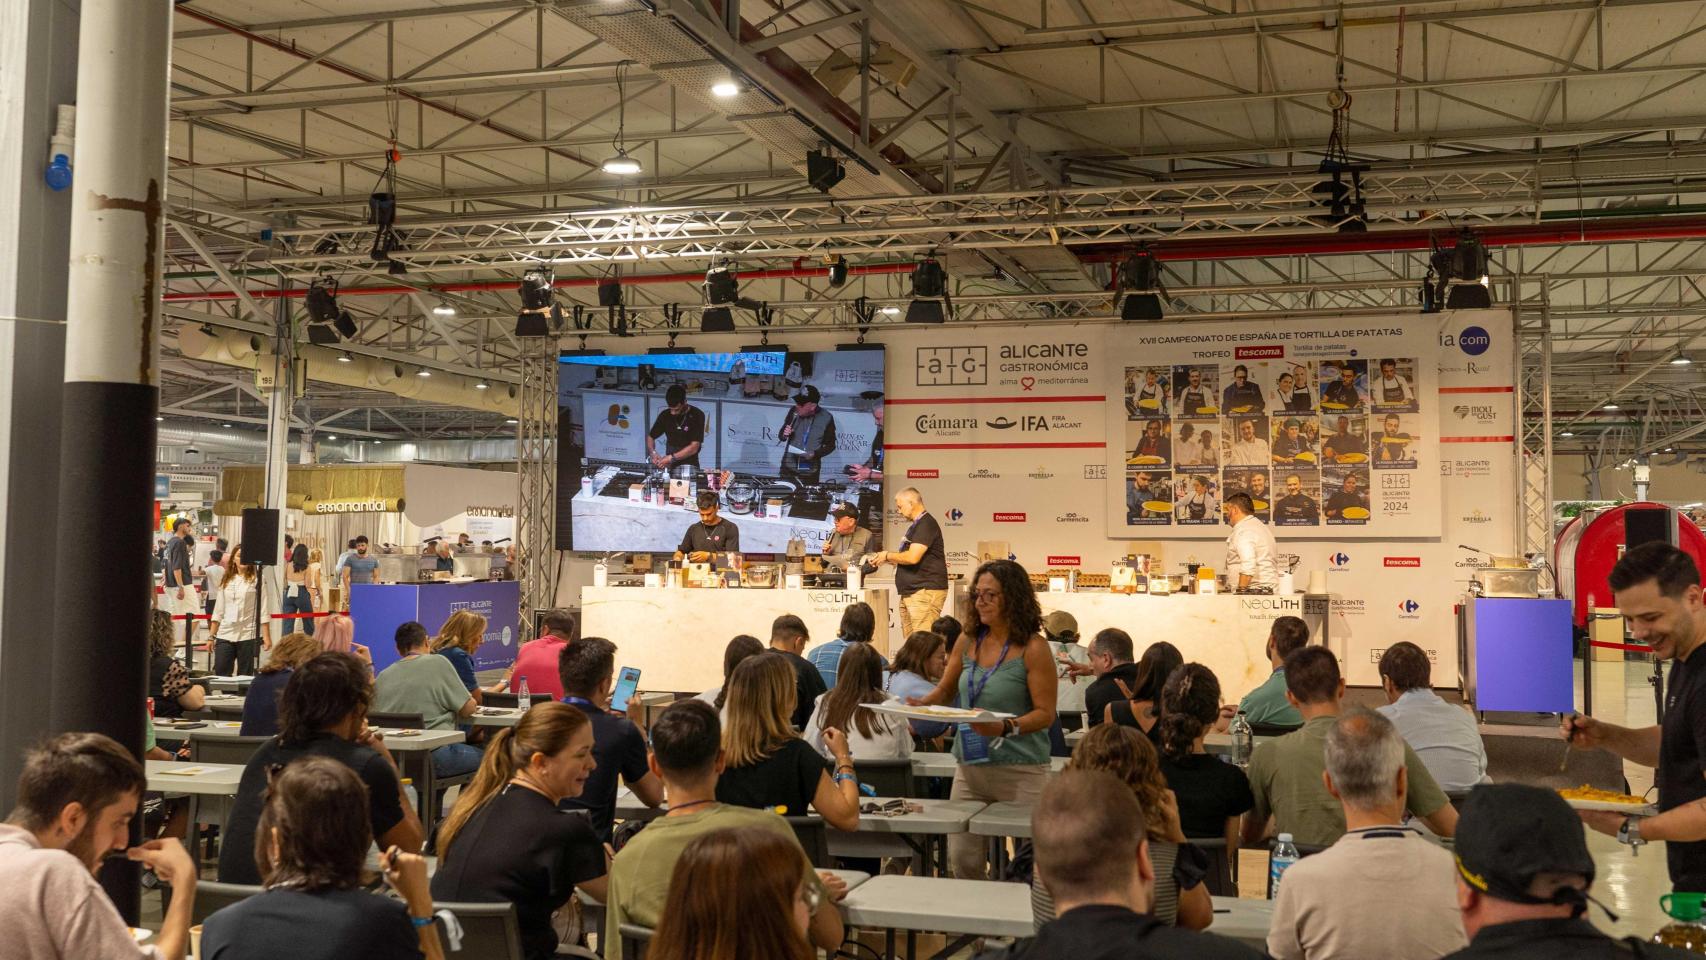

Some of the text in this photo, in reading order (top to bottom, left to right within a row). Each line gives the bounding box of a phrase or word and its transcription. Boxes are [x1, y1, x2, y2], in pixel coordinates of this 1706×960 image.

[1158, 334, 1224, 344] CAMPEONATO
[1239, 332, 1277, 341] ESPAÑA
[1294, 331, 1340, 339] TORTILLA
[1356, 328, 1403, 336] PATATAS
[1460, 336, 1488, 345] com
[1038, 377, 1088, 385] mediterránea
[1022, 416, 1049, 431] IFA
[316, 499, 386, 512] emanantial
[1384, 502, 1408, 510] 2024
